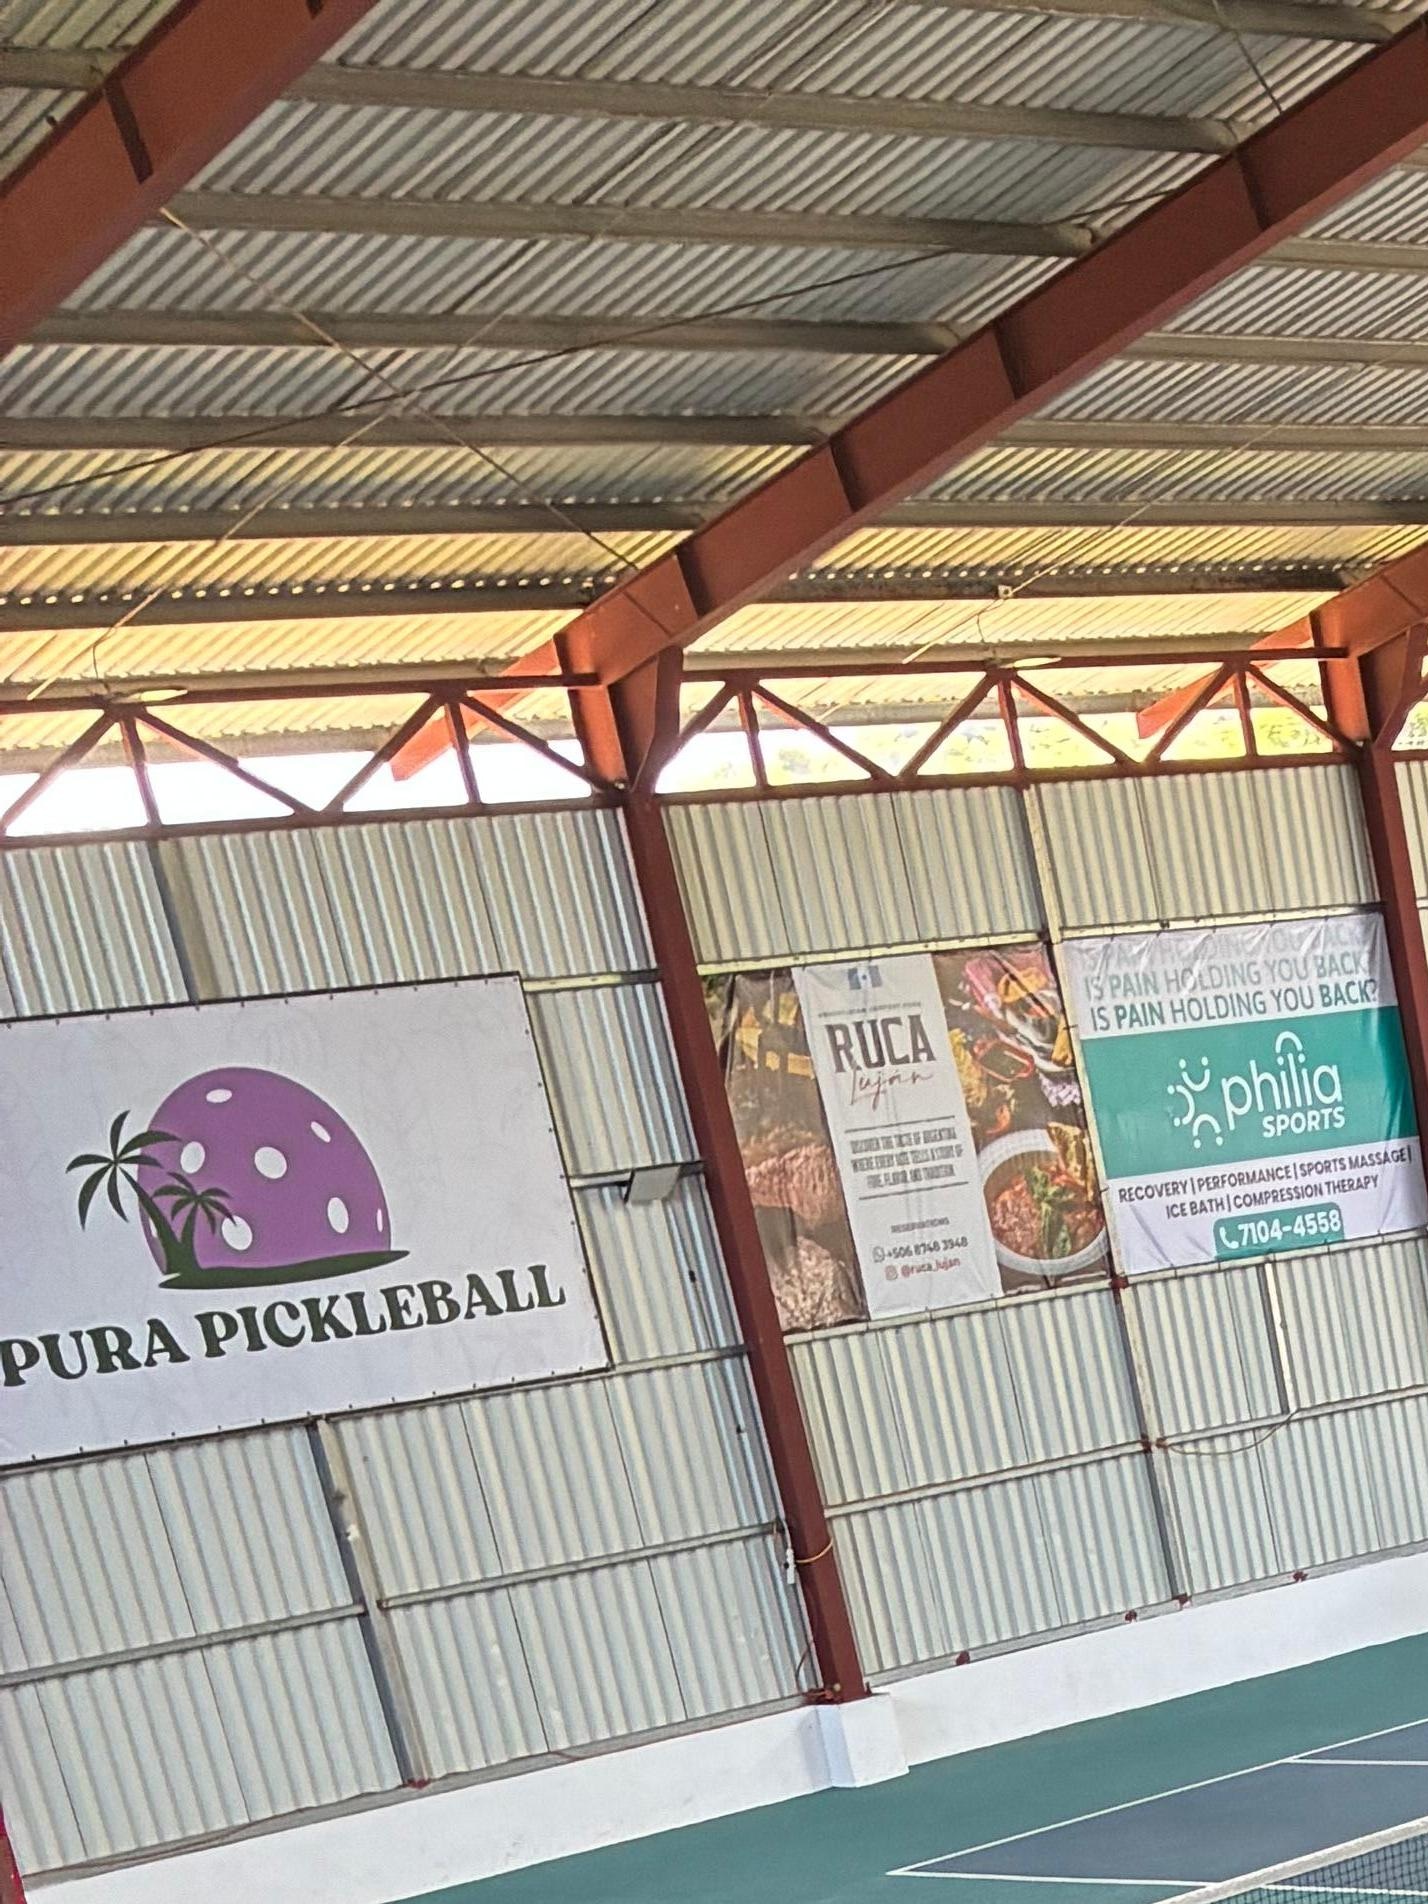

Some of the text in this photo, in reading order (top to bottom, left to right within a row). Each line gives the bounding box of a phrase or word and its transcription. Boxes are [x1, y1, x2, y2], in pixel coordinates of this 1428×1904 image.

[1084, 976, 1104, 1001] IS
[1108, 970, 1160, 1000] PAIN
[1164, 960, 1262, 994] HOLDING
[1263, 956, 1309, 983] YOU
[1090, 978, 1378, 1031] IS PAIN HOLDING YOU BACK?
[824, 1014, 937, 1073] RUCA
[1221, 1053, 1343, 1130] philia
[1262, 1106, 1346, 1138] SPORTS
[1118, 1182, 1189, 1203] RECOVERY
[1197, 1166, 1293, 1192] PERFORMANCE
[1299, 1158, 1346, 1178] SPORTS
[1348, 1147, 1406, 1169] MASSAGE
[1166, 1201, 1187, 1219] ICE
[1189, 1194, 1226, 1217] BATH
[1233, 1182, 1324, 1209] COMPRESSION
[1325, 1174, 1380, 1193] THERAPY
[1237, 1209, 1343, 1247] 7104-4558
[1, 1264, 567, 1387] PURA PICKLEBALL
